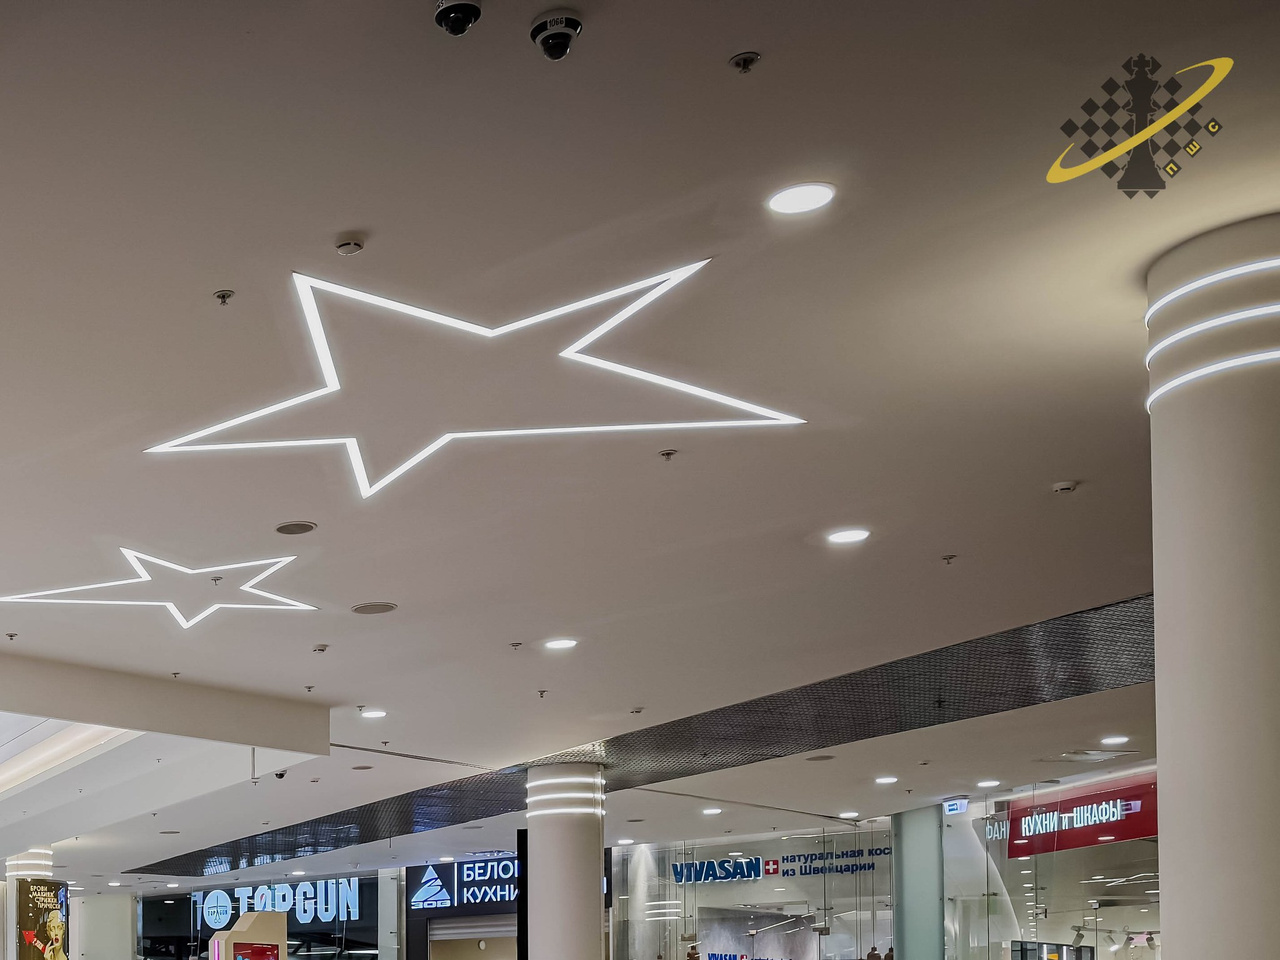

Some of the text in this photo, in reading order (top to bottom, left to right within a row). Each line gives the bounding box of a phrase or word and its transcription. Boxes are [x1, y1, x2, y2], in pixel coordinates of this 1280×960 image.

[1021, 811, 1058, 836] КУХНИ
[1073, 799, 1121, 828] ШКАФЫ
[782, 847, 893, 866] натуральная кос
[463, 860, 518, 882] БЕЛО
[672, 856, 763, 884] VIVASAN
[782, 862, 875, 877] из Швейцарии
